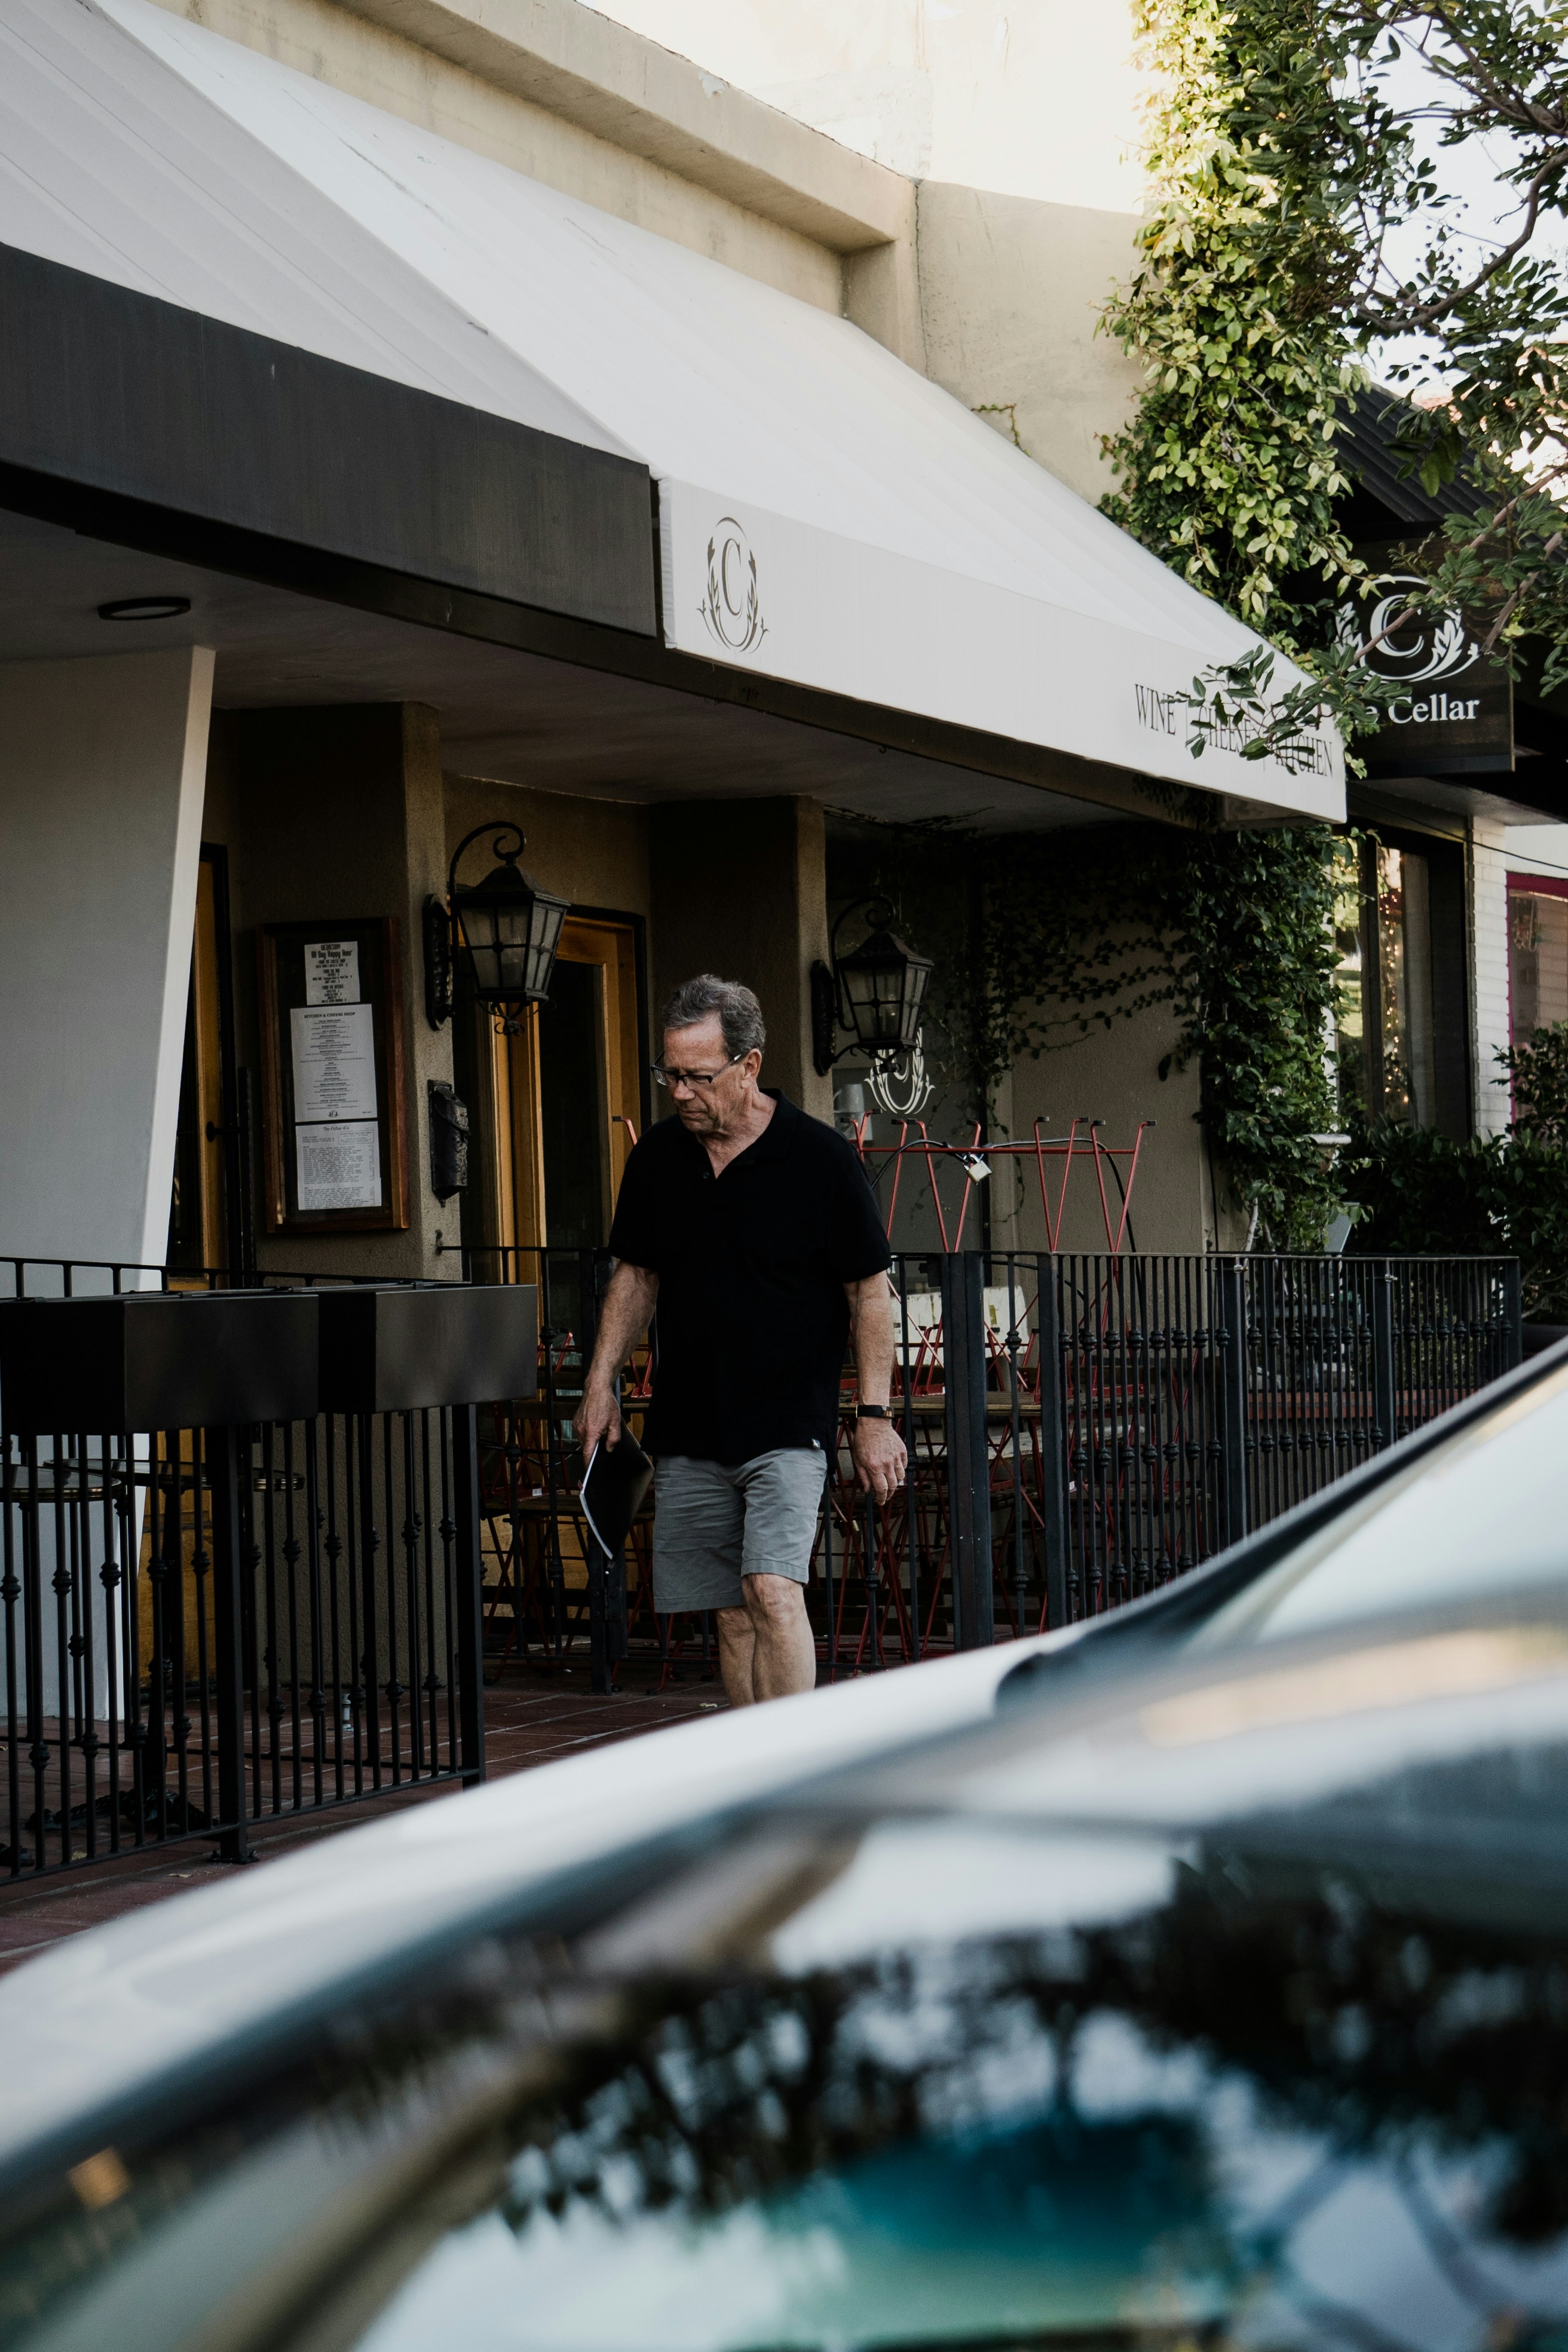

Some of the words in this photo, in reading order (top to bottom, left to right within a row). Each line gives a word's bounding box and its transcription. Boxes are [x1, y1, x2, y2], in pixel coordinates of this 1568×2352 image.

[1135, 684, 1176, 736] WINE
[1388, 693, 1481, 724] Cellar
[318, 951, 326, 960] Day
[327, 950, 341, 959] Happy
